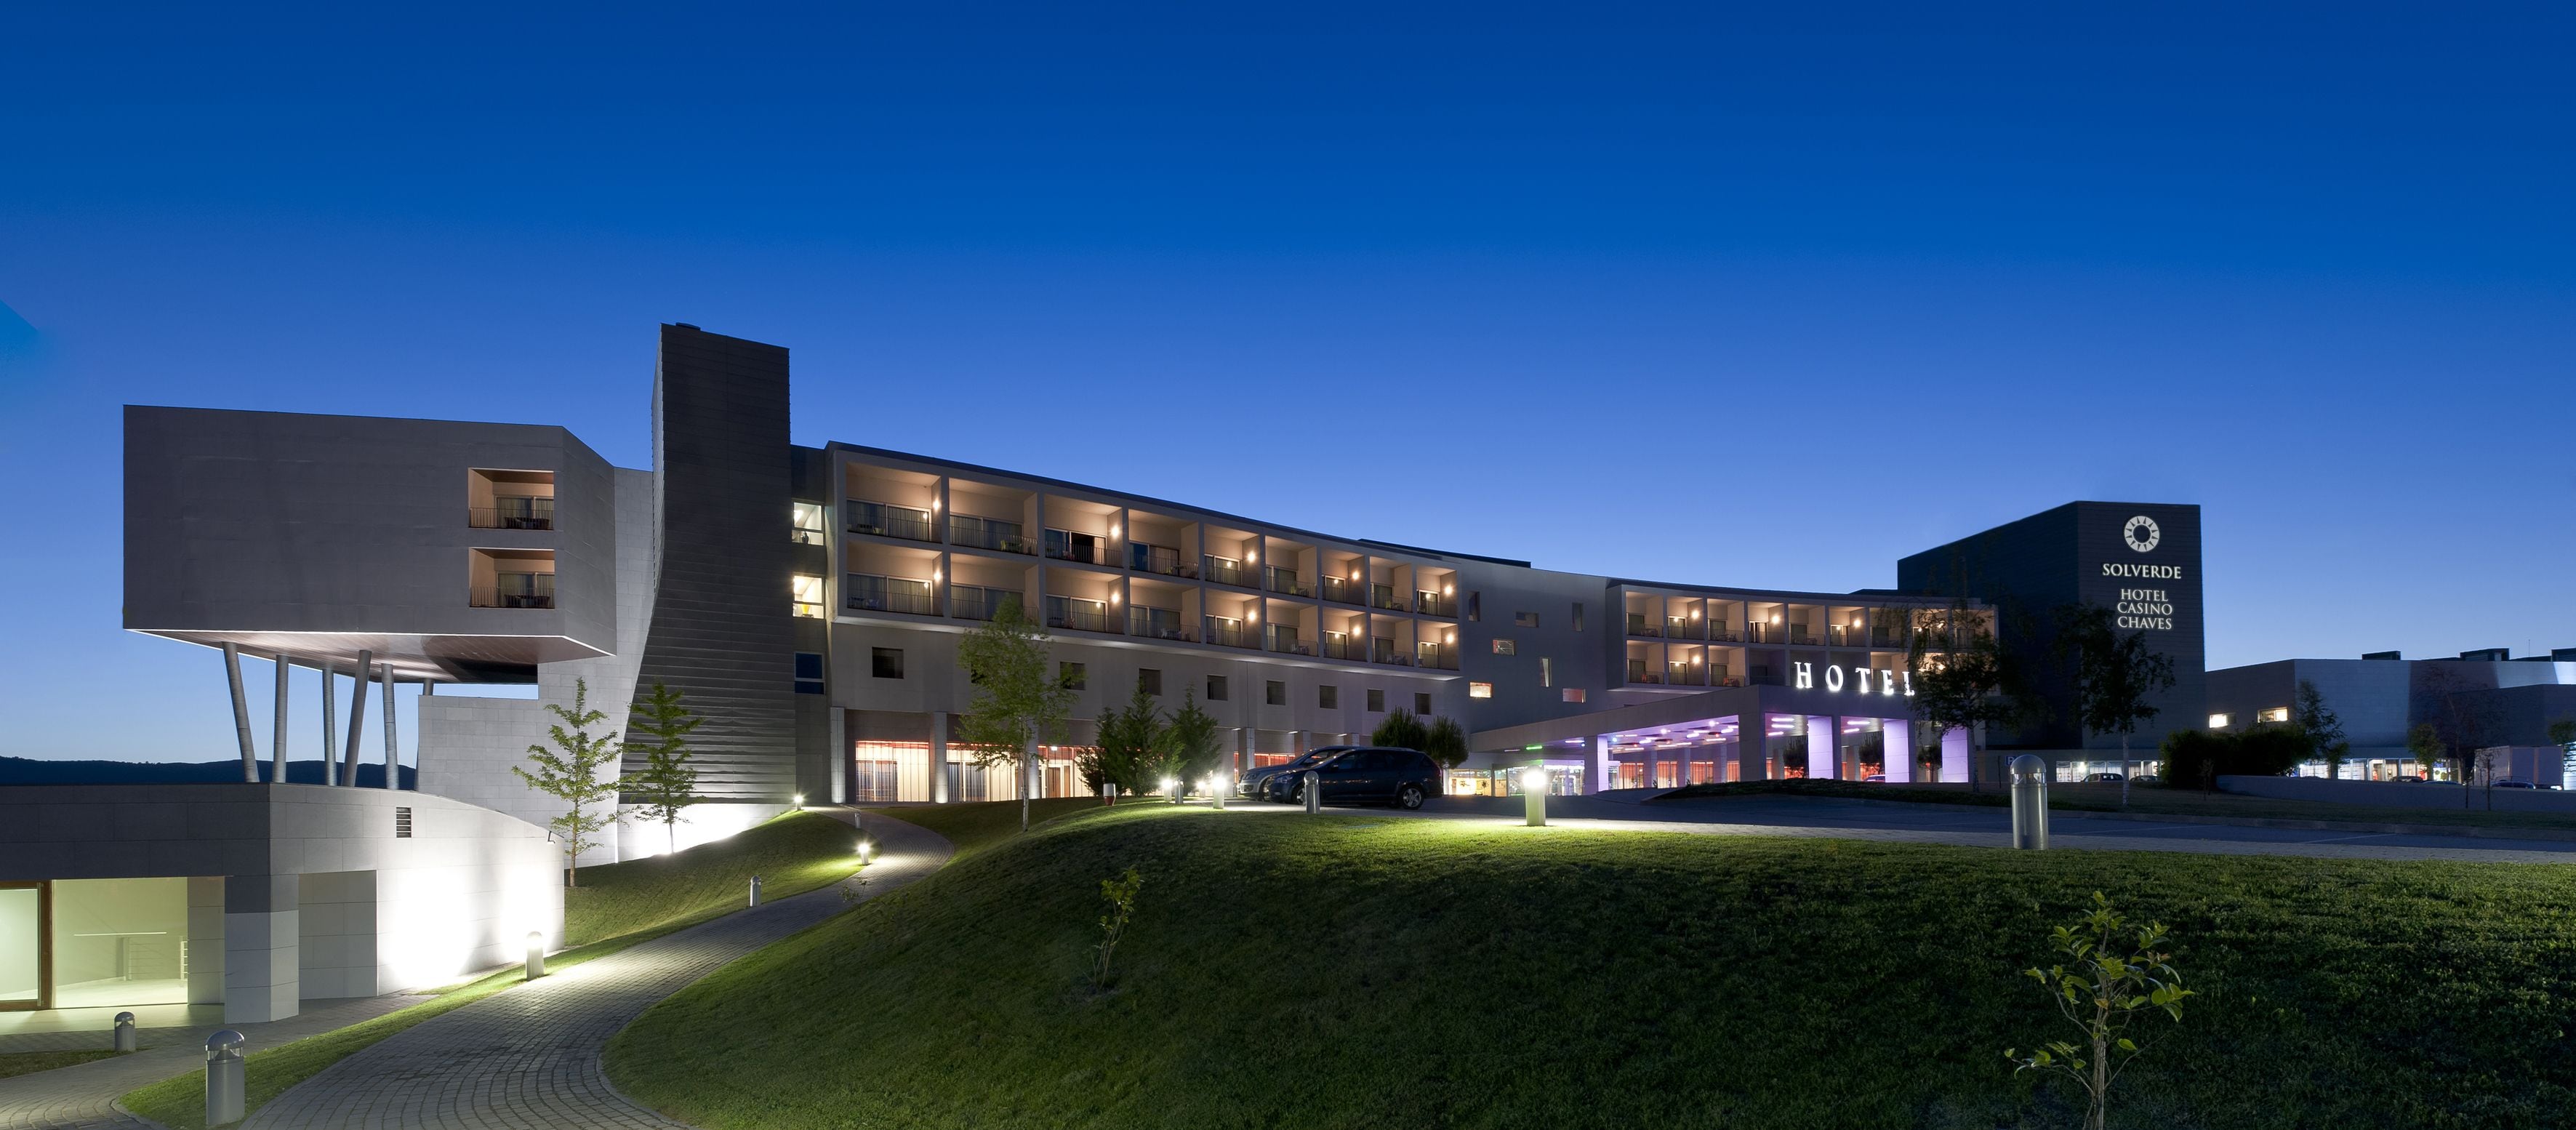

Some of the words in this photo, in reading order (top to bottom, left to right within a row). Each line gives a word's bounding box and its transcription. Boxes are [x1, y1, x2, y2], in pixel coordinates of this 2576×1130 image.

[2103, 564, 2181, 579] SOLVERDE
[2121, 589, 2168, 601] HOTEL
[2117, 602, 2172, 615] CASINO
[2117, 617, 2172, 630] CHAVES
[1794, 662, 1915, 696] HOTEL
